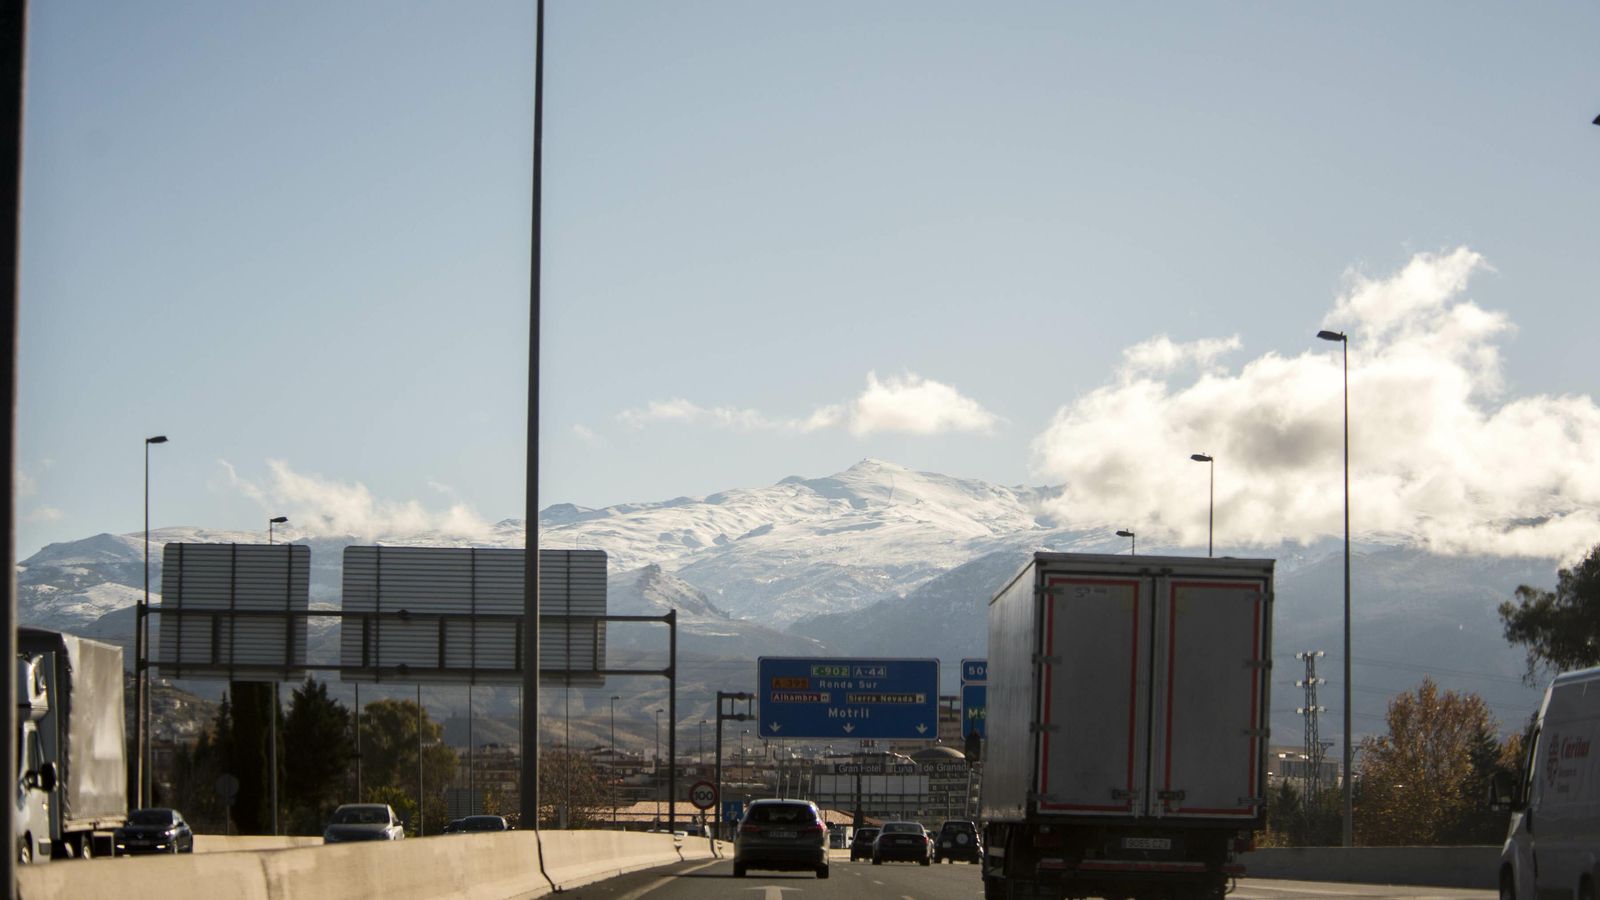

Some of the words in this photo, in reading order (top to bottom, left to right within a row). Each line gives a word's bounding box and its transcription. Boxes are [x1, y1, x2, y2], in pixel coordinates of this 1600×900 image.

[812, 665, 848, 676] E-902
[855, 665, 885, 676] A-44
[819, 680, 853, 689] Ronda
[859, 680, 878, 689] Sur
[773, 694, 818, 702] Alhambra
[848, 695, 877, 703] Sierra
[880, 695, 914, 703] Nevada
[828, 707, 870, 719] Motril
[839, 764, 858, 774] Gran
[861, 763, 881, 773] Hotel
[923, 763, 934, 772] de
